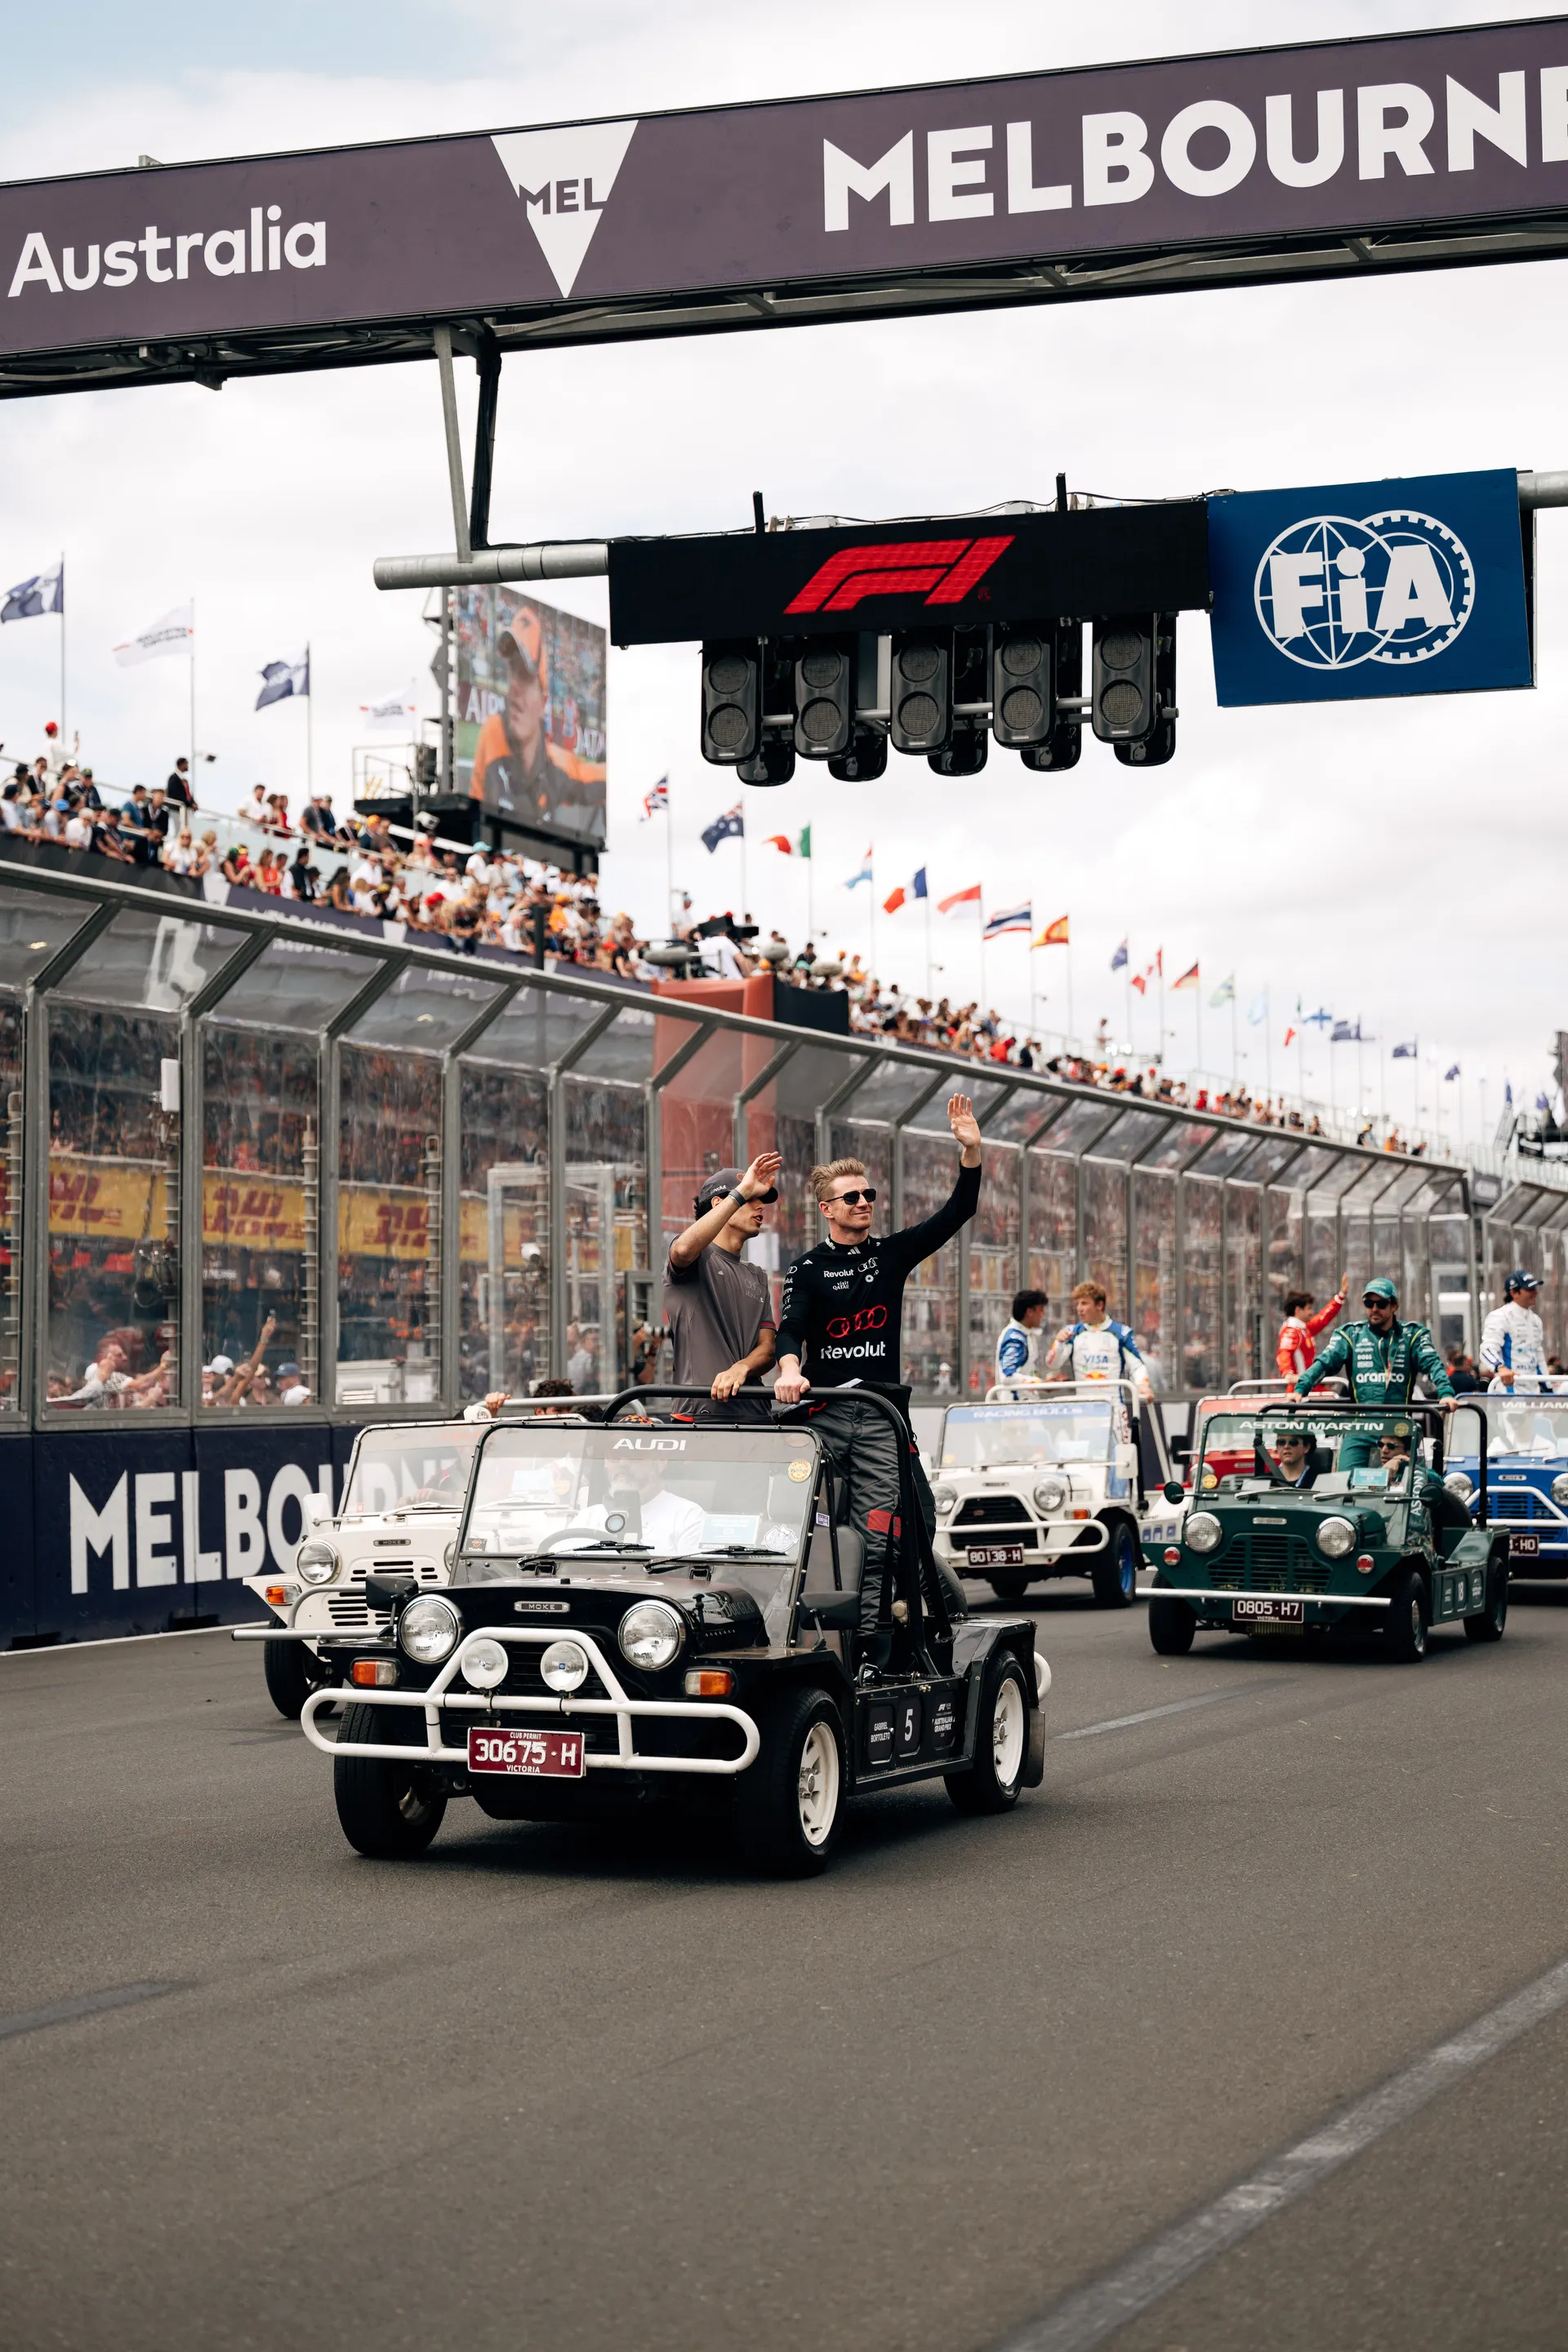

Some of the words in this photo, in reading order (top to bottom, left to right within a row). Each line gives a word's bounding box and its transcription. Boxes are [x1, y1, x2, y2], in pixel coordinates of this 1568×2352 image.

[519, 176, 608, 217] MEL
[7, 204, 327, 299] Australia
[784, 535, 1016, 614] F1
[823, 1269, 854, 1278] Revolut
[820, 1341, 886, 1359] Revolut
[1084, 1354, 1109, 1364] VISA
[1356, 1372, 1405, 1383] aramco
[973, 1410, 1031, 1419] RACING
[1032, 1407, 1082, 1415] BULLS
[1239, 1420, 1304, 1430] ASTON
[1307, 1422, 1384, 1431] MARTIN
[612, 1438, 687, 1451] AUDI
[874, 1722, 889, 1731] GABRIEL
[904, 1708, 914, 1741] 5
[933, 1716, 954, 1726] AUSTRALIAN
[933, 1724, 945, 1733] GRAND
[943, 1722, 952, 1731] PRIX
[510, 1731, 523, 1740] CLUB
[523, 1732, 542, 1740] PERMIT
[871, 1731, 891, 1743] BORTOLETO
[506, 1764, 541, 1774] VICTORIA
